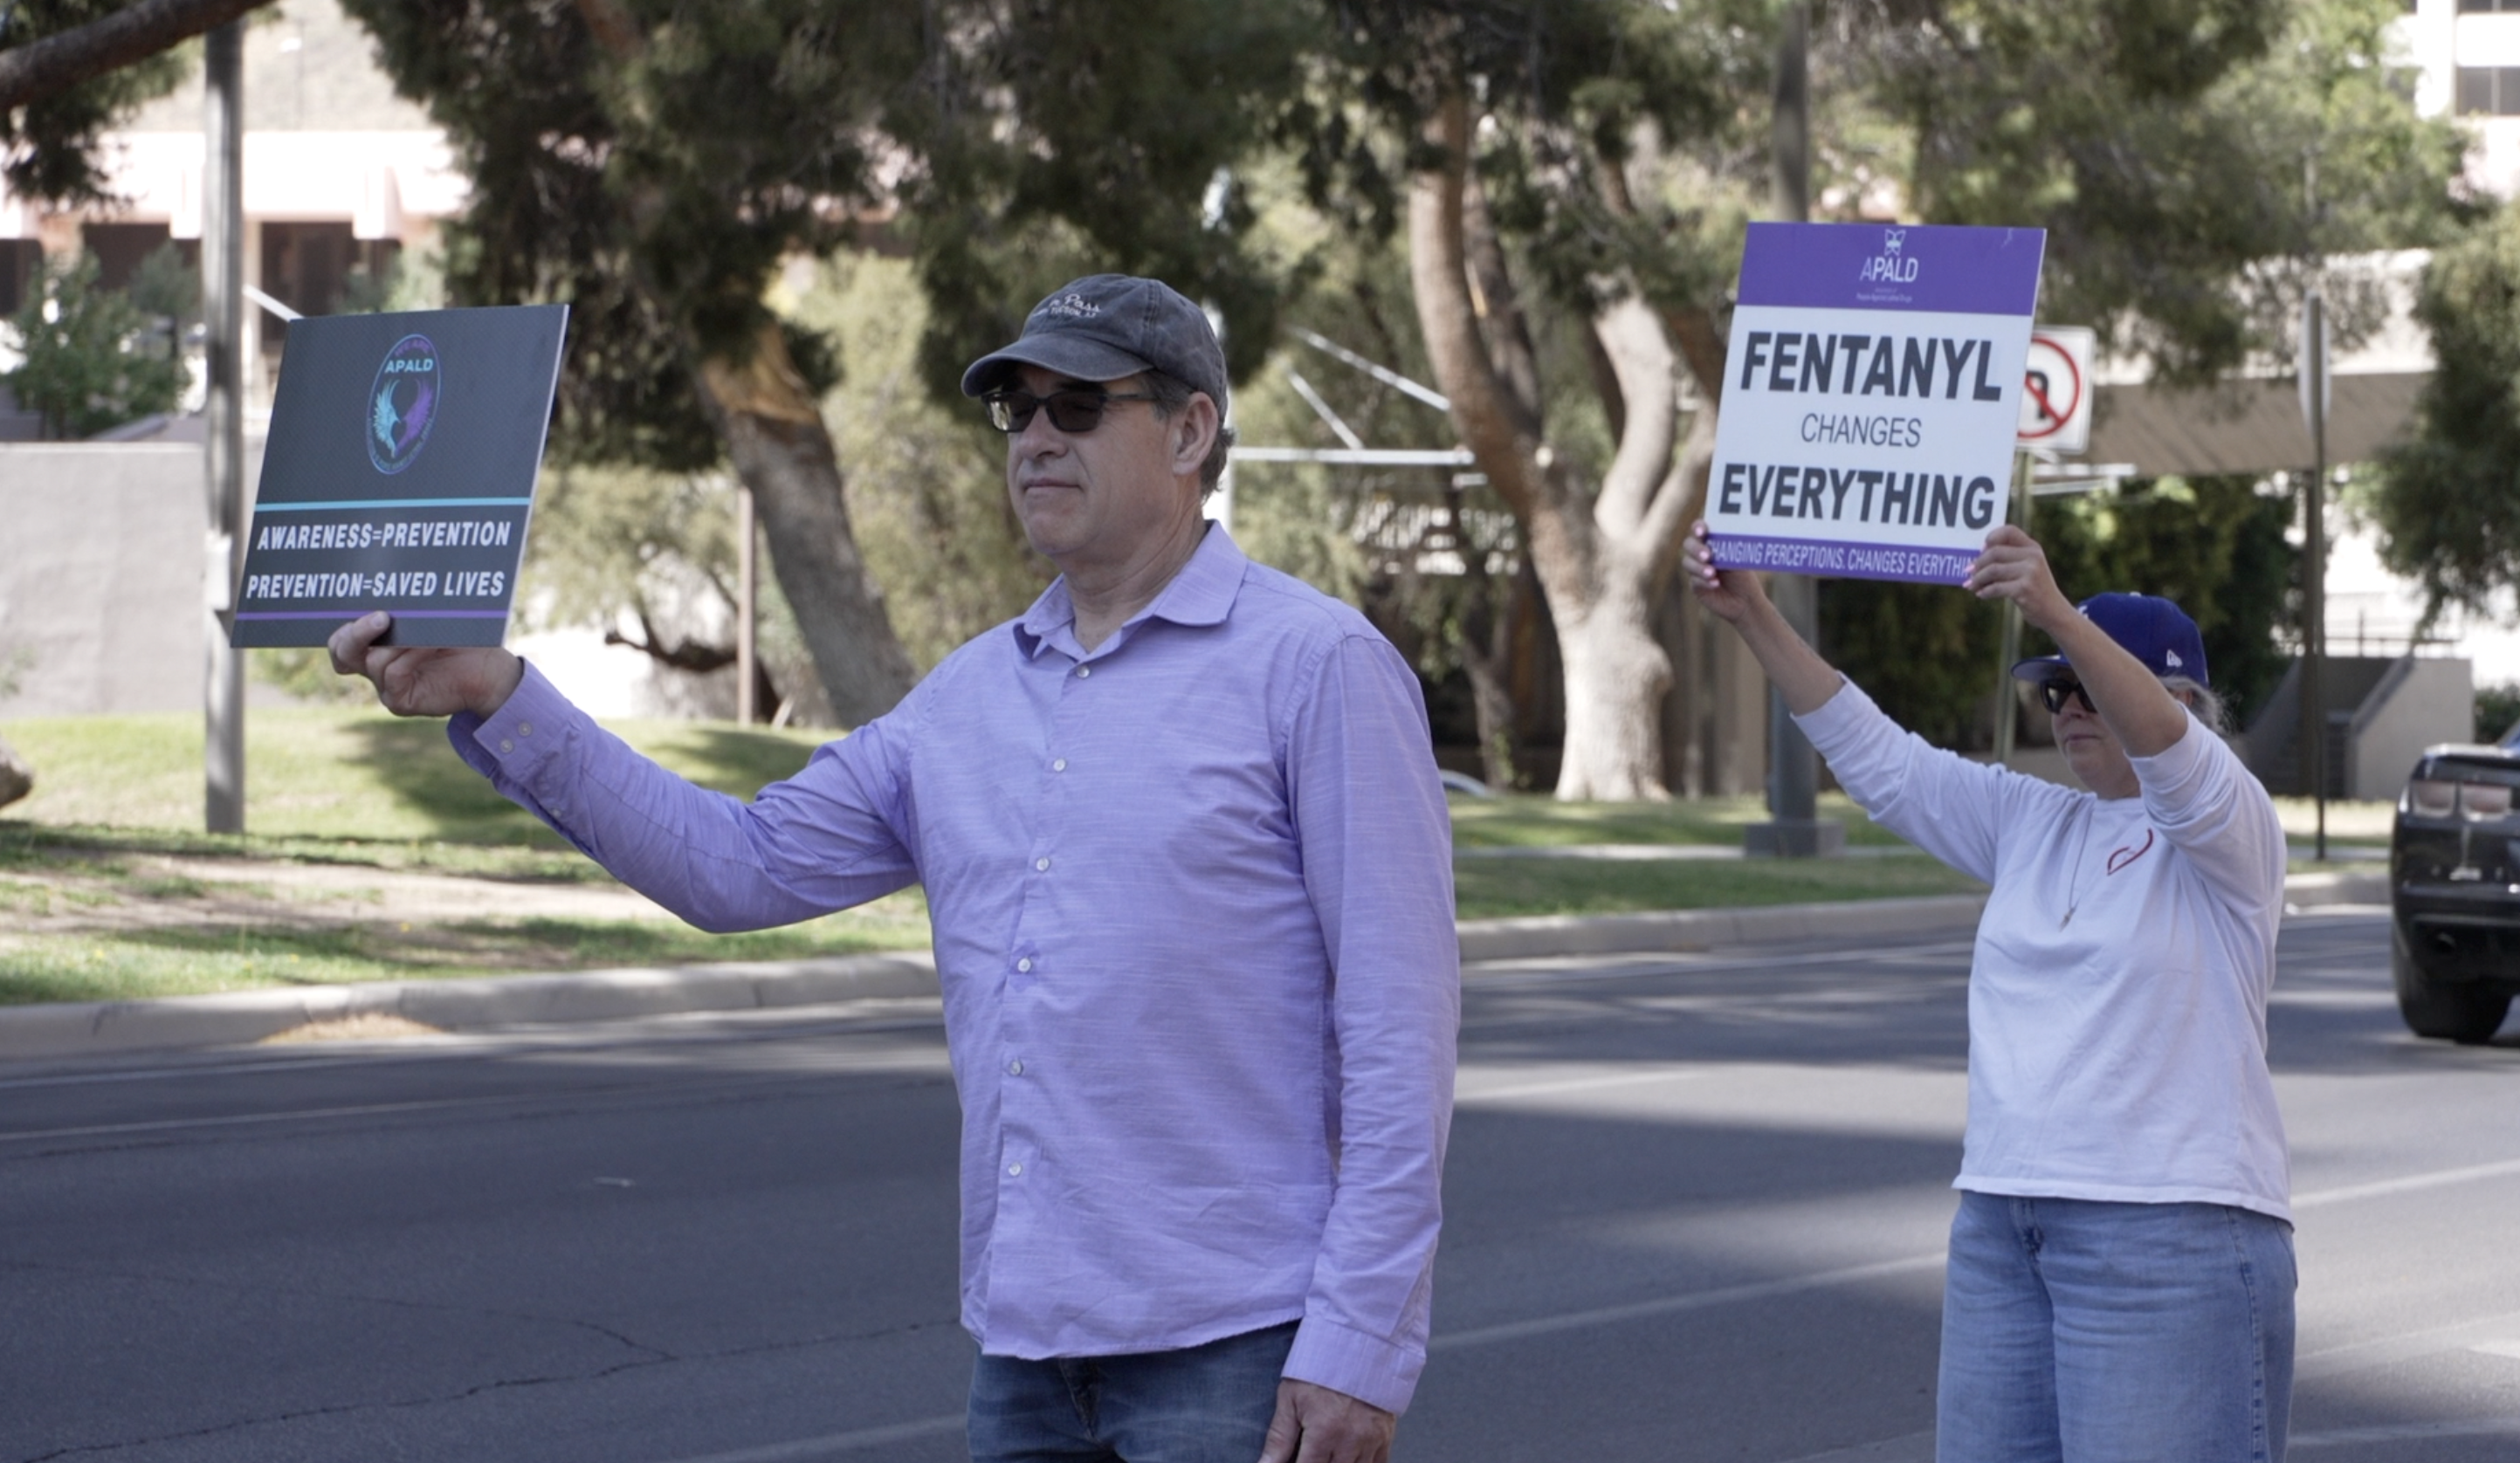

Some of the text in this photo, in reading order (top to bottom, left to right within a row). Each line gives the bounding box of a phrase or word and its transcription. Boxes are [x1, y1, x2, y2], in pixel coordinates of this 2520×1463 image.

[1859, 256, 1919, 283] APALD
[384, 358, 435, 374] APALD
[1740, 331, 2002, 402] FENTANYL
[1800, 412, 1923, 448] CHANGES
[1718, 463, 1996, 530] EVERYTHING
[257, 521, 512, 550] AWARENESS=PREVENTION
[1765, 543, 1846, 570] PERCEPTIONS.
[1848, 548, 1906, 574] CHANGES
[246, 571, 505, 598] PREVENTION=SAVED LIVES
